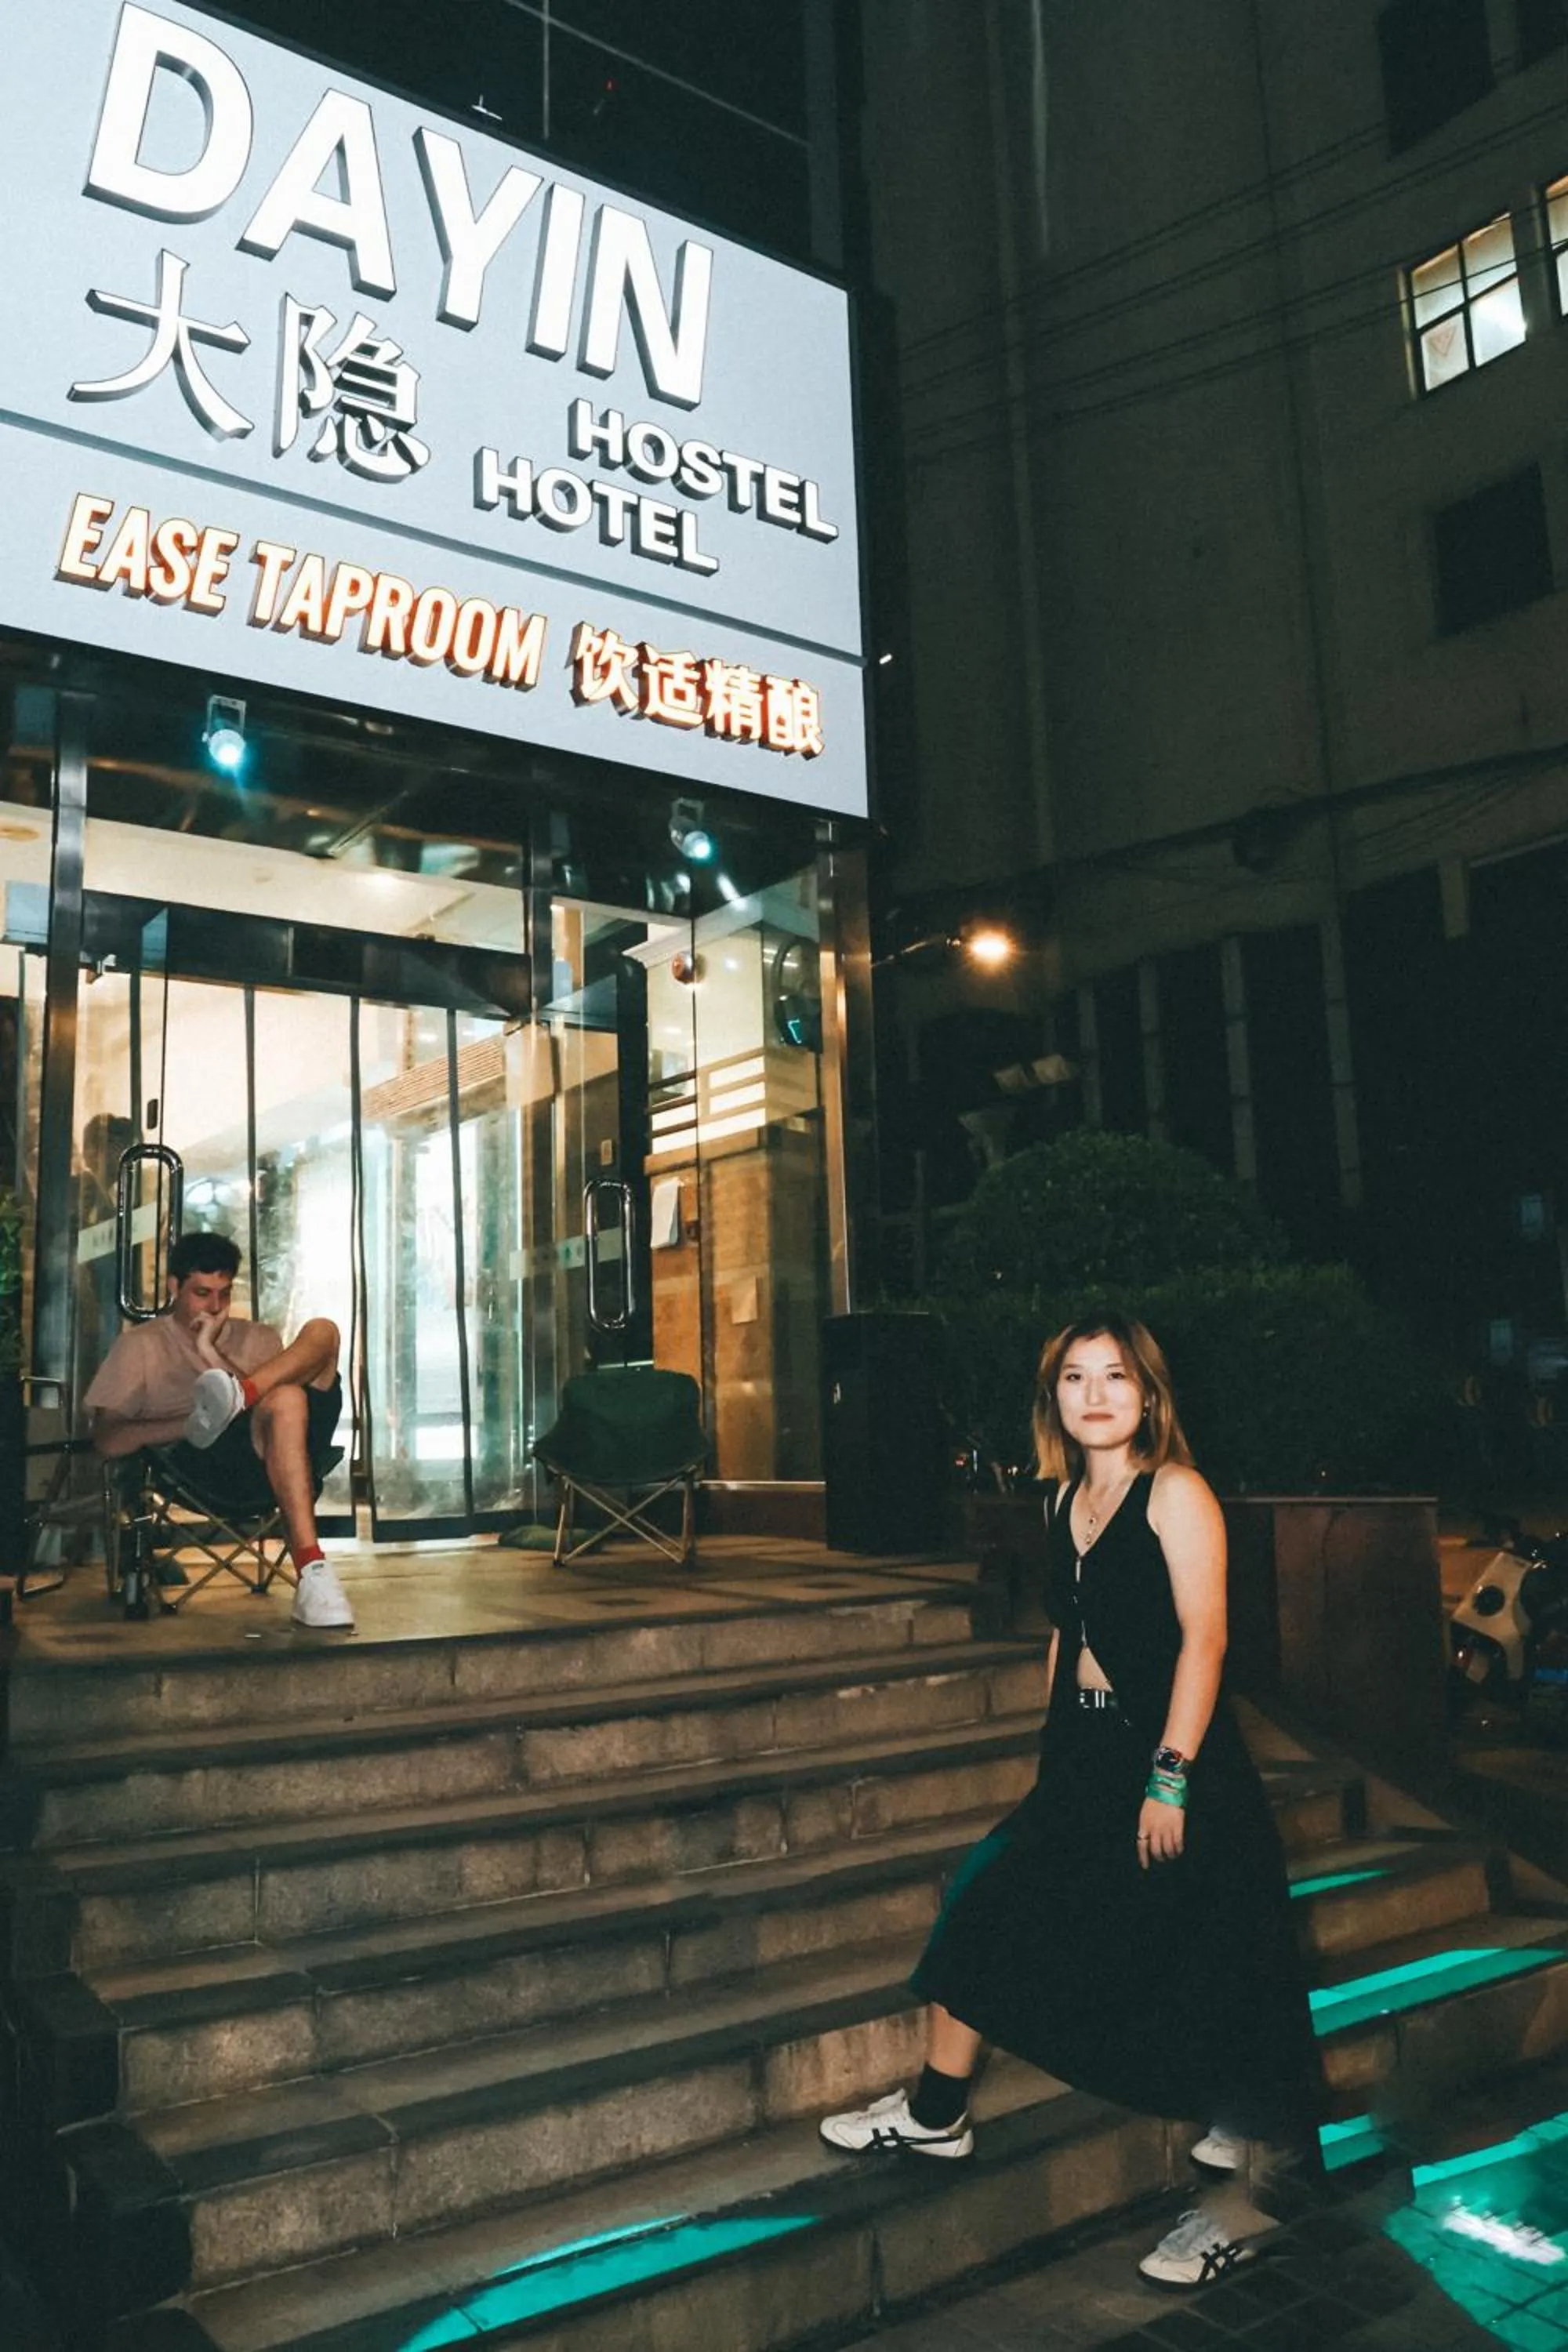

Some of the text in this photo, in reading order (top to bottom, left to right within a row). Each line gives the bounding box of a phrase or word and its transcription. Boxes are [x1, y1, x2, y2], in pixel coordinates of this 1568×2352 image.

[82, 1, 714, 410] DAYIN
[67, 249, 430, 484] 大隐
[473, 447, 720, 576] HOTEL
[568, 398, 839, 543] HOSTEL
[55, 493, 547, 691] EASE TAPROOM
[567, 622, 824, 759] 饮适精酿
